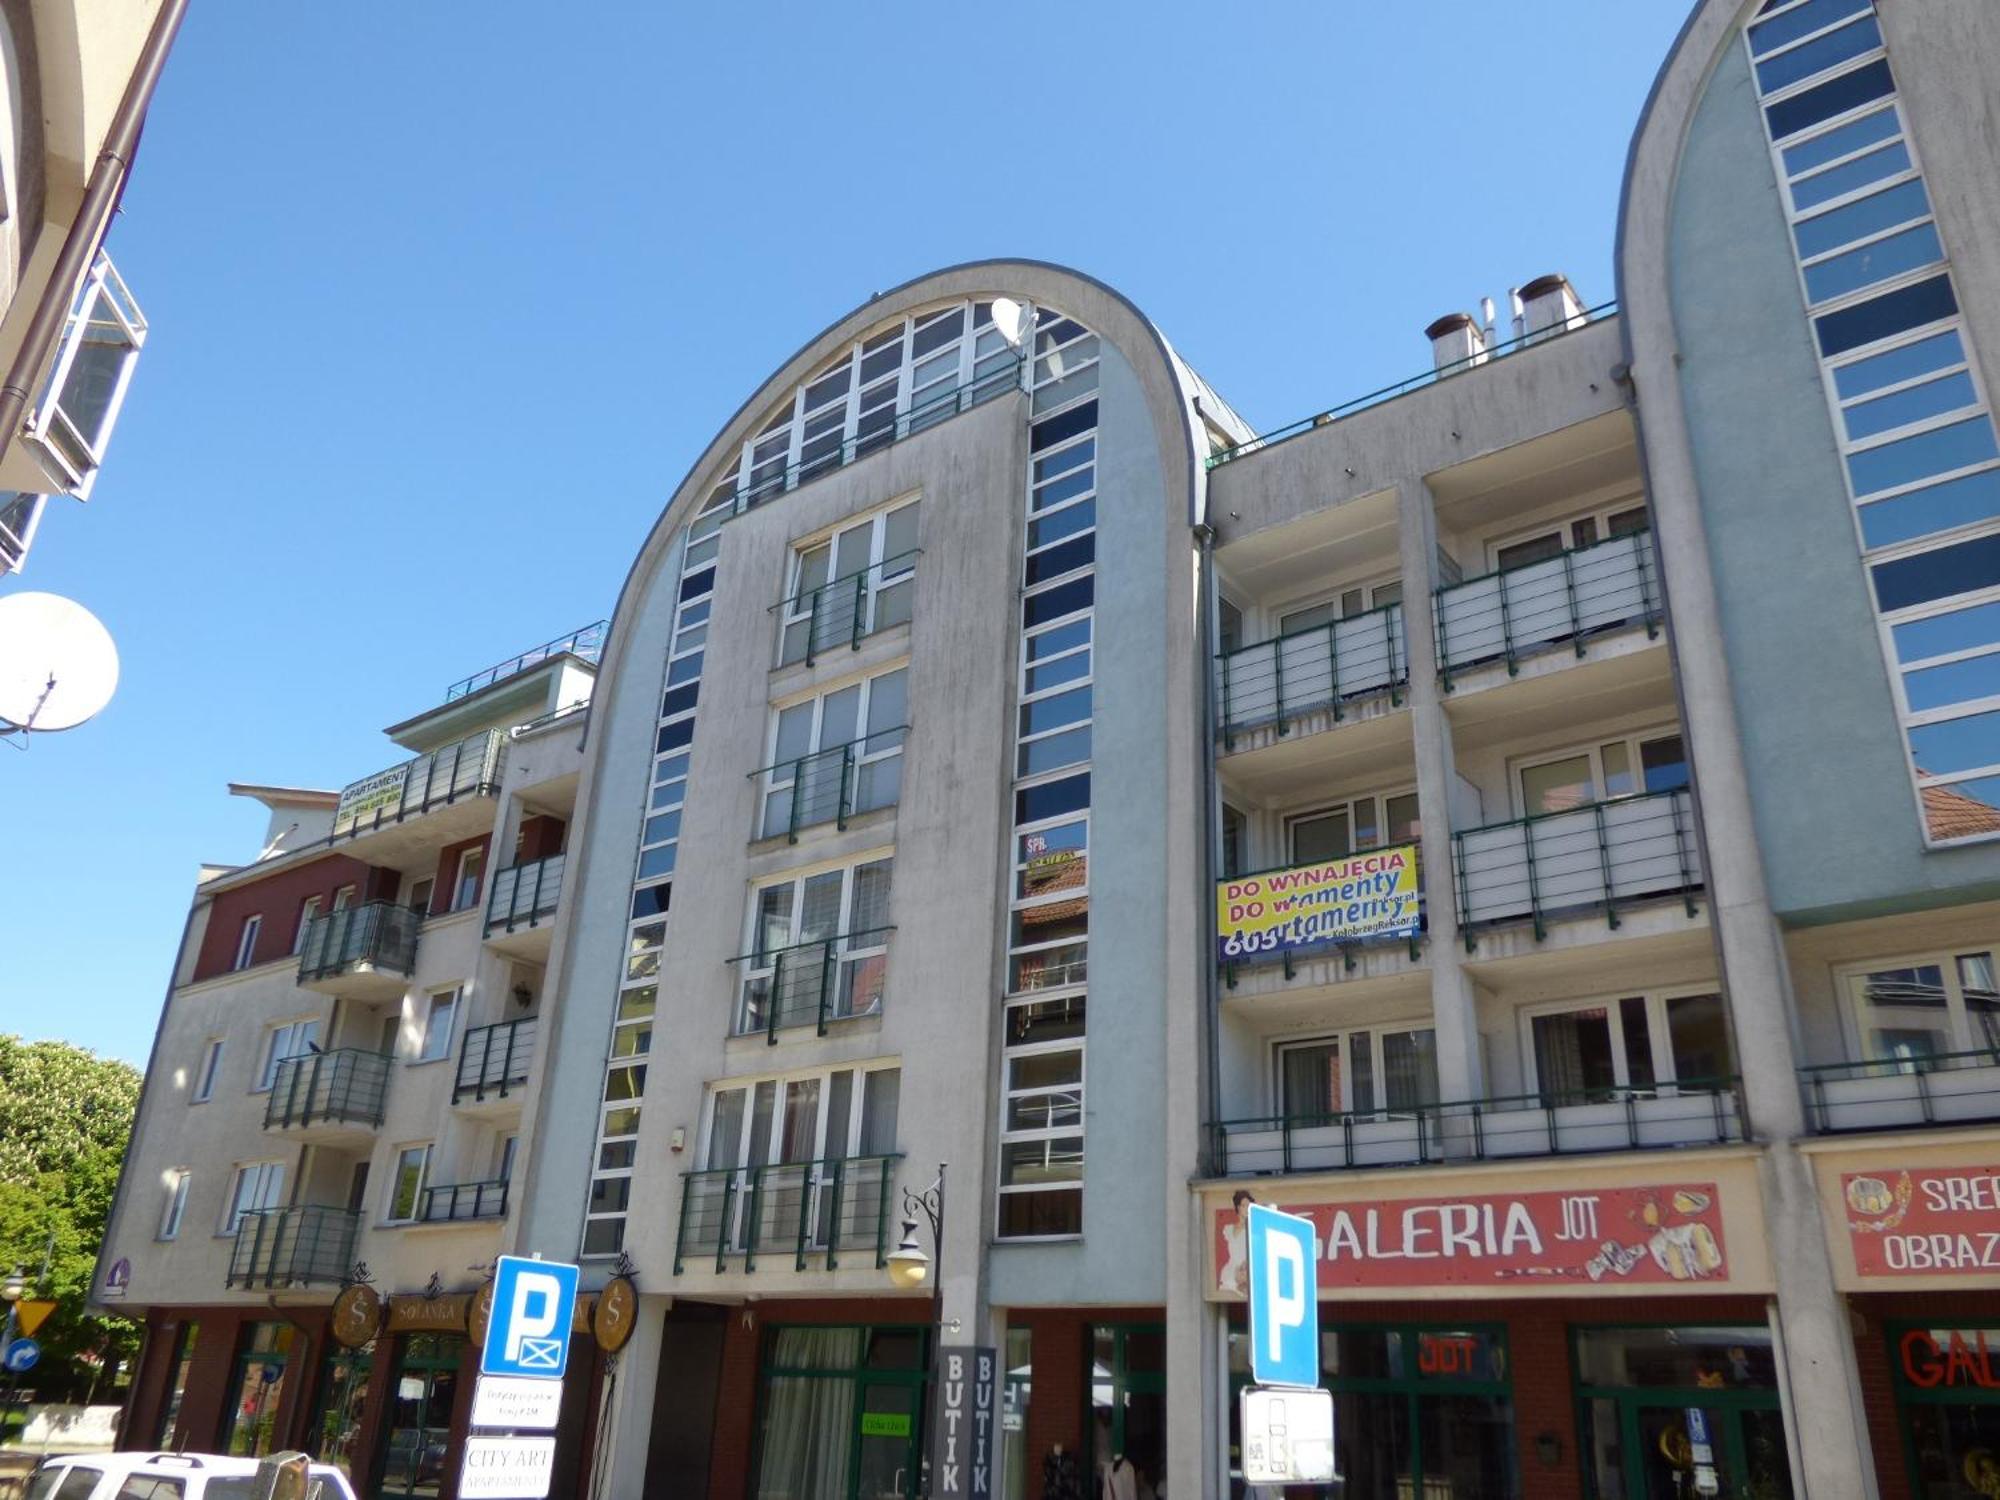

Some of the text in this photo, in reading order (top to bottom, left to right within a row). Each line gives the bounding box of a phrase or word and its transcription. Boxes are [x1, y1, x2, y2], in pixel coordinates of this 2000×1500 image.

[1227, 853, 1405, 901] DO WYNAJĘCIA
[1230, 902, 1265, 923] DO
[1554, 1196, 1600, 1241] JOT
[504, 1271, 561, 1361] P
[1266, 1227, 1305, 1363] P
[1418, 1335, 1476, 1374] JOT
[942, 1355, 964, 1492] BUTIK
[973, 1356, 991, 1493] BUTIK
[468, 1449, 550, 1468] CITY ART
